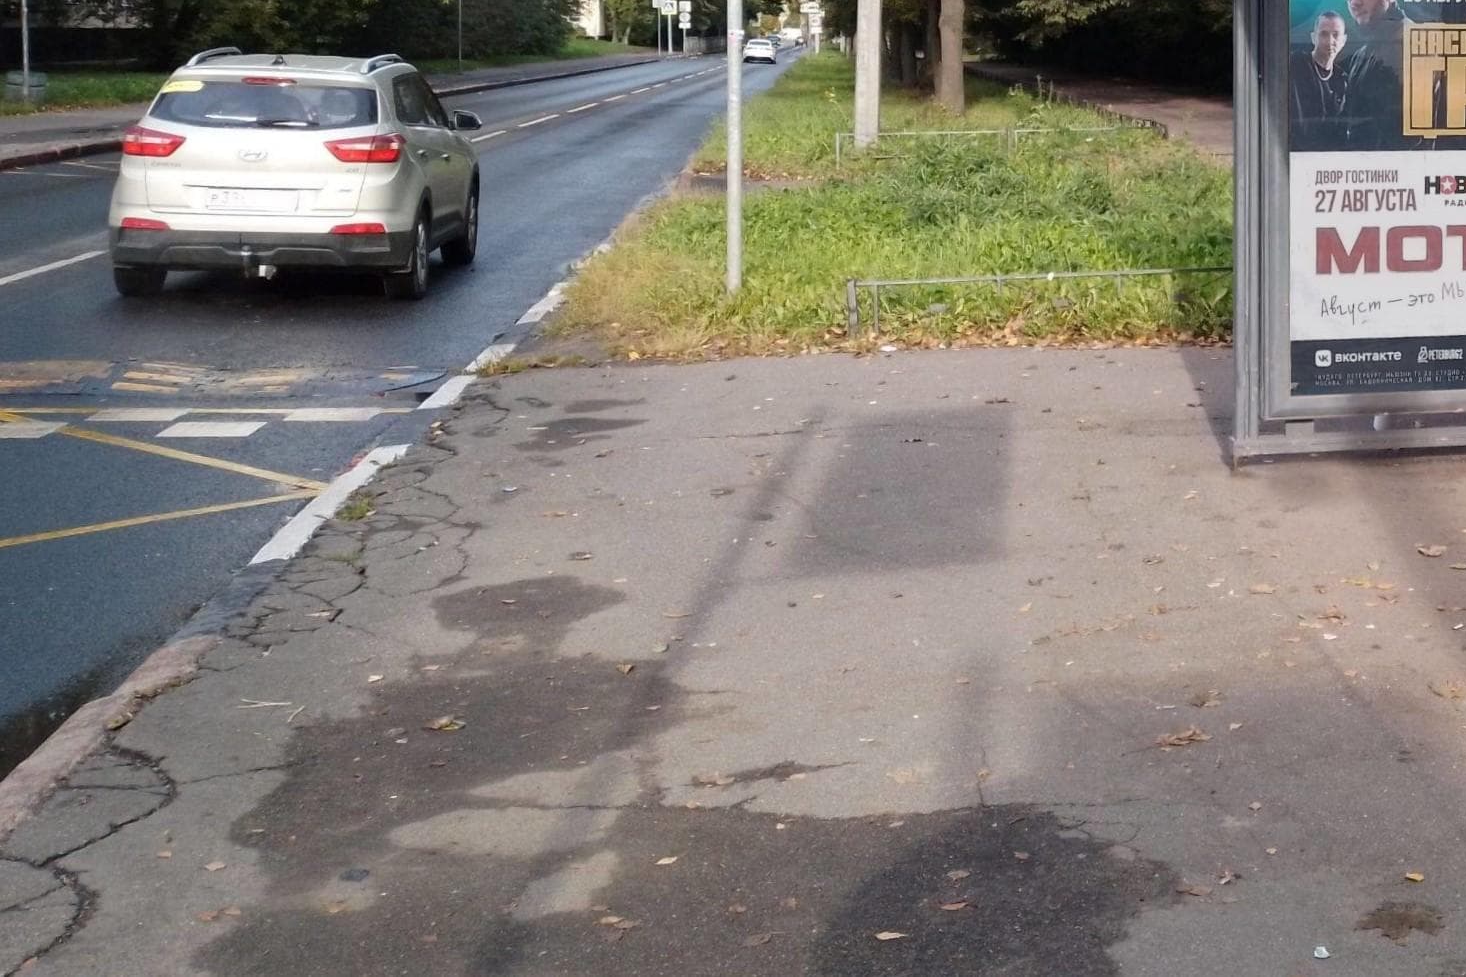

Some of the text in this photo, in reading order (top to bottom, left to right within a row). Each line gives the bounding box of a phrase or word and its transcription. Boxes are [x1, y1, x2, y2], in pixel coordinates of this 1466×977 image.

[1315, 169, 1399, 186] ДВОР ГОСТИНКИ
[1315, 188, 1417, 213] 27 АВГУСТА
[1320, 295, 1381, 325] Август
